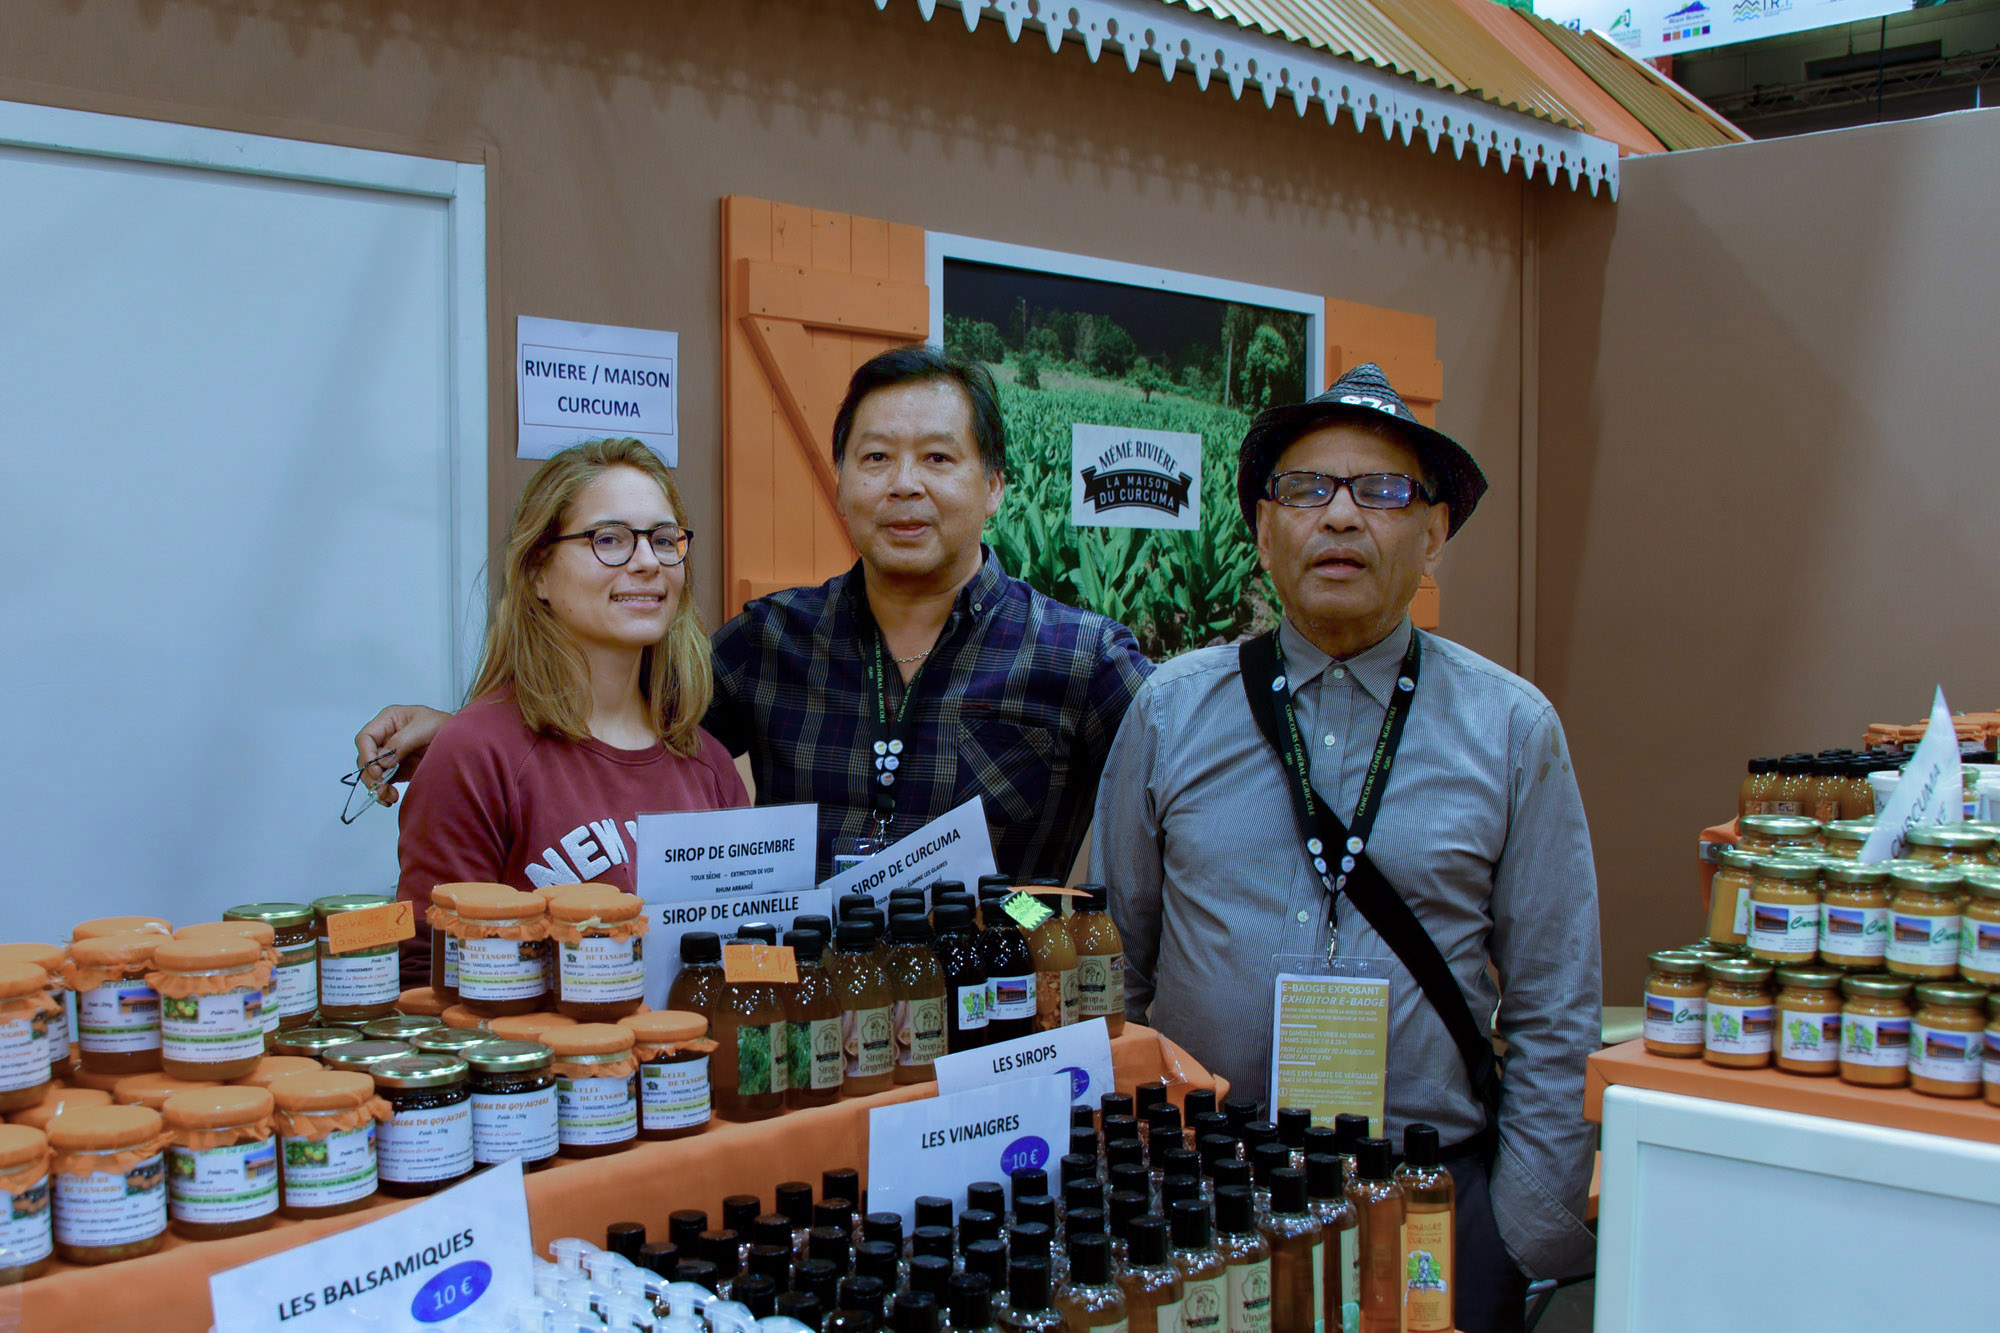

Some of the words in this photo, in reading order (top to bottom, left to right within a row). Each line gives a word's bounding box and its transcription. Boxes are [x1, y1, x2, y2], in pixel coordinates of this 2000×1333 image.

[525, 359, 587, 381] RIVIERE
[592, 364, 599, 385] /
[604, 367, 670, 388] MAISON
[557, 395, 641, 418] CURCUMA
[1098, 439, 1133, 472] MÉMÉ
[1136, 440, 1178, 476] RIVIÈRE
[1106, 476, 1120, 488] LA
[1127, 476, 1169, 491] MAISON
[1100, 490, 1115, 505] DU
[1119, 488, 1174, 509] CURCUMA
[1284, 704, 1299, 743] CONCOURS
[1301, 777, 1316, 817] AGRICOLE
[1356, 776, 1375, 817] CONCOURS
[1382, 706, 1398, 742] AGRICOLE
[524, 818, 629, 888] NEW
[664, 846, 705, 863] SIROP
[708, 845, 725, 860] DE
[728, 838, 795, 858] GINGEMBRE
[851, 869, 886, 895] SIROP
[888, 859, 904, 878] DE
[905, 828, 961, 868] CURCUMA
[690, 873, 705, 881] TOUX
[730, 868, 757, 878] EXTINCTION
[765, 866, 774, 875] VOIX
[715, 885, 731, 894] RHUM
[663, 907, 707, 925] SIROP
[711, 904, 729, 920] DE
[732, 896, 799, 917] CANNELLE
[1281, 983, 1326, 993] E-BADGE
[1328, 985, 1381, 996] EXPOSANT
[1281, 994, 1337, 1006] EXHIBITOR
[1339, 996, 1386, 1008] E-BADGE
[993, 1056, 1013, 1074] LES
[1018, 1044, 1058, 1067] SIROPS
[922, 1130, 945, 1149] LES
[950, 1114, 1020, 1144] VINAIGRES
[1012, 1152, 1028, 1170] 10
[1030, 1149, 1039, 1165] €
[1406, 1223, 1442, 1231] VINAIGRE
[278, 1292, 317, 1321] LES
[324, 1228, 475, 1306] BALSAMIQUES
[434, 1284, 456, 1311] 10
[460, 1275, 473, 1296] €
